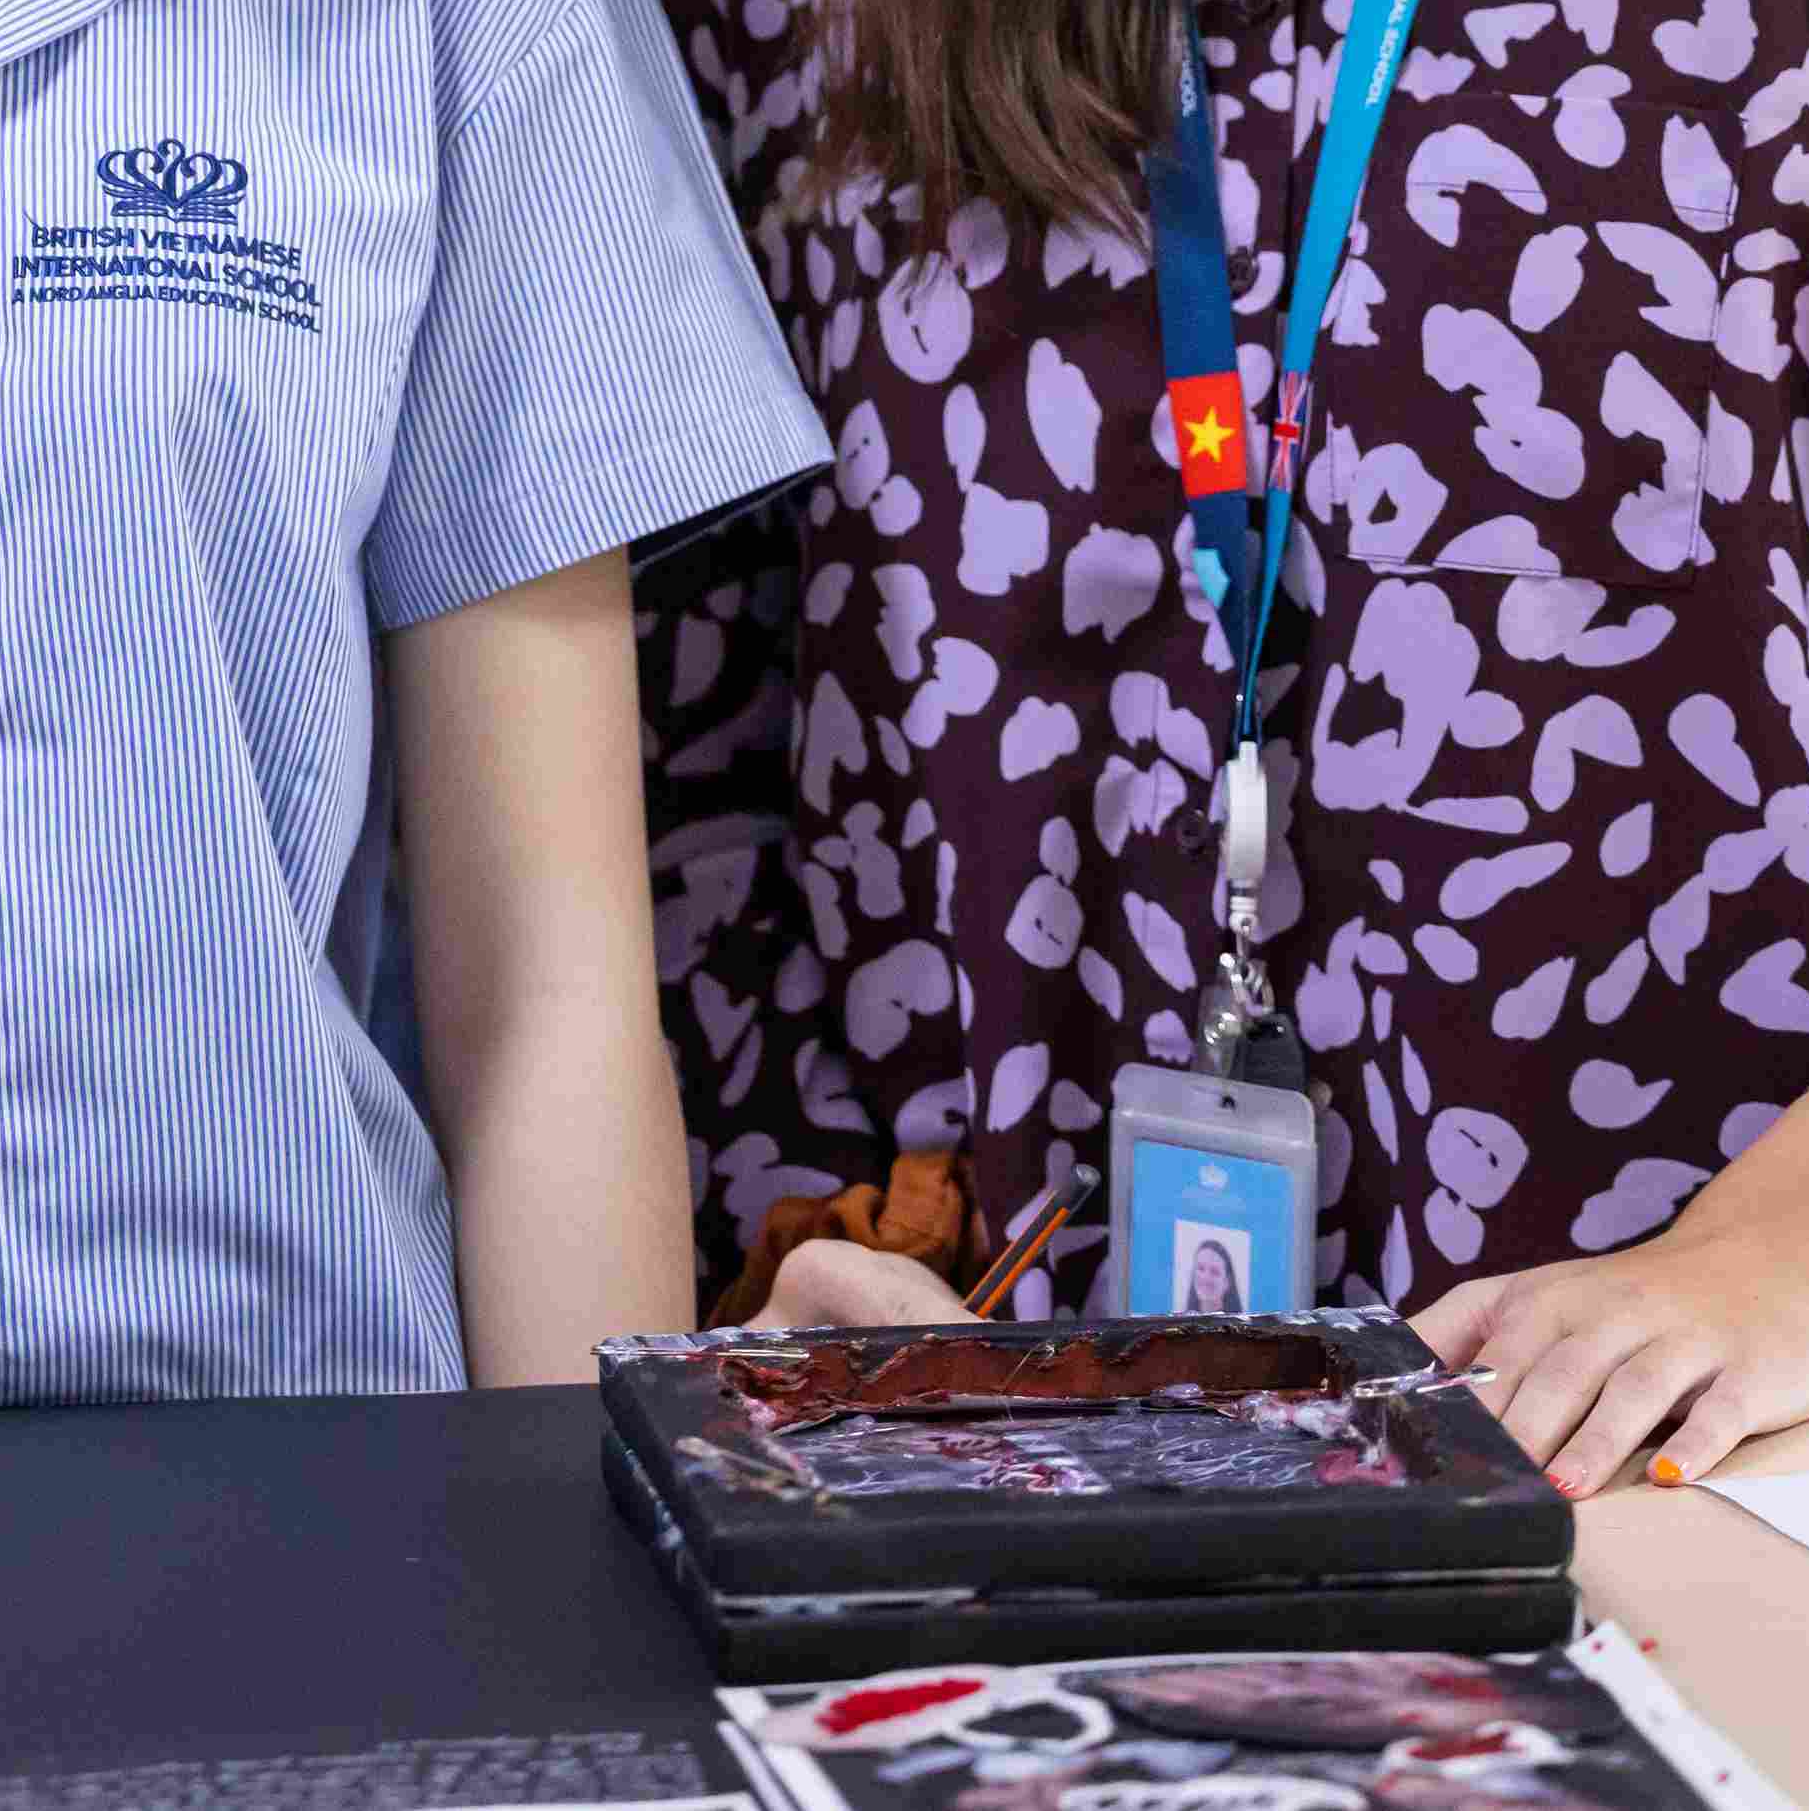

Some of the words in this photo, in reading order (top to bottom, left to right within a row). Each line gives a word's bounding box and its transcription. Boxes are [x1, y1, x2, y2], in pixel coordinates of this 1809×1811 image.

[31, 225, 135, 248] BRITISH
[140, 229, 302, 271] VIETNAMESE
[13, 254, 220, 280] INTERNATIONAL
[222, 263, 322, 307] SCHOOL
[12, 288, 25, 304] A
[30, 286, 82, 302] NORD
[84, 284, 155, 301] ANGLIA
[157, 285, 256, 316] EDUCATION
[258, 301, 322, 334] SCHOOL
